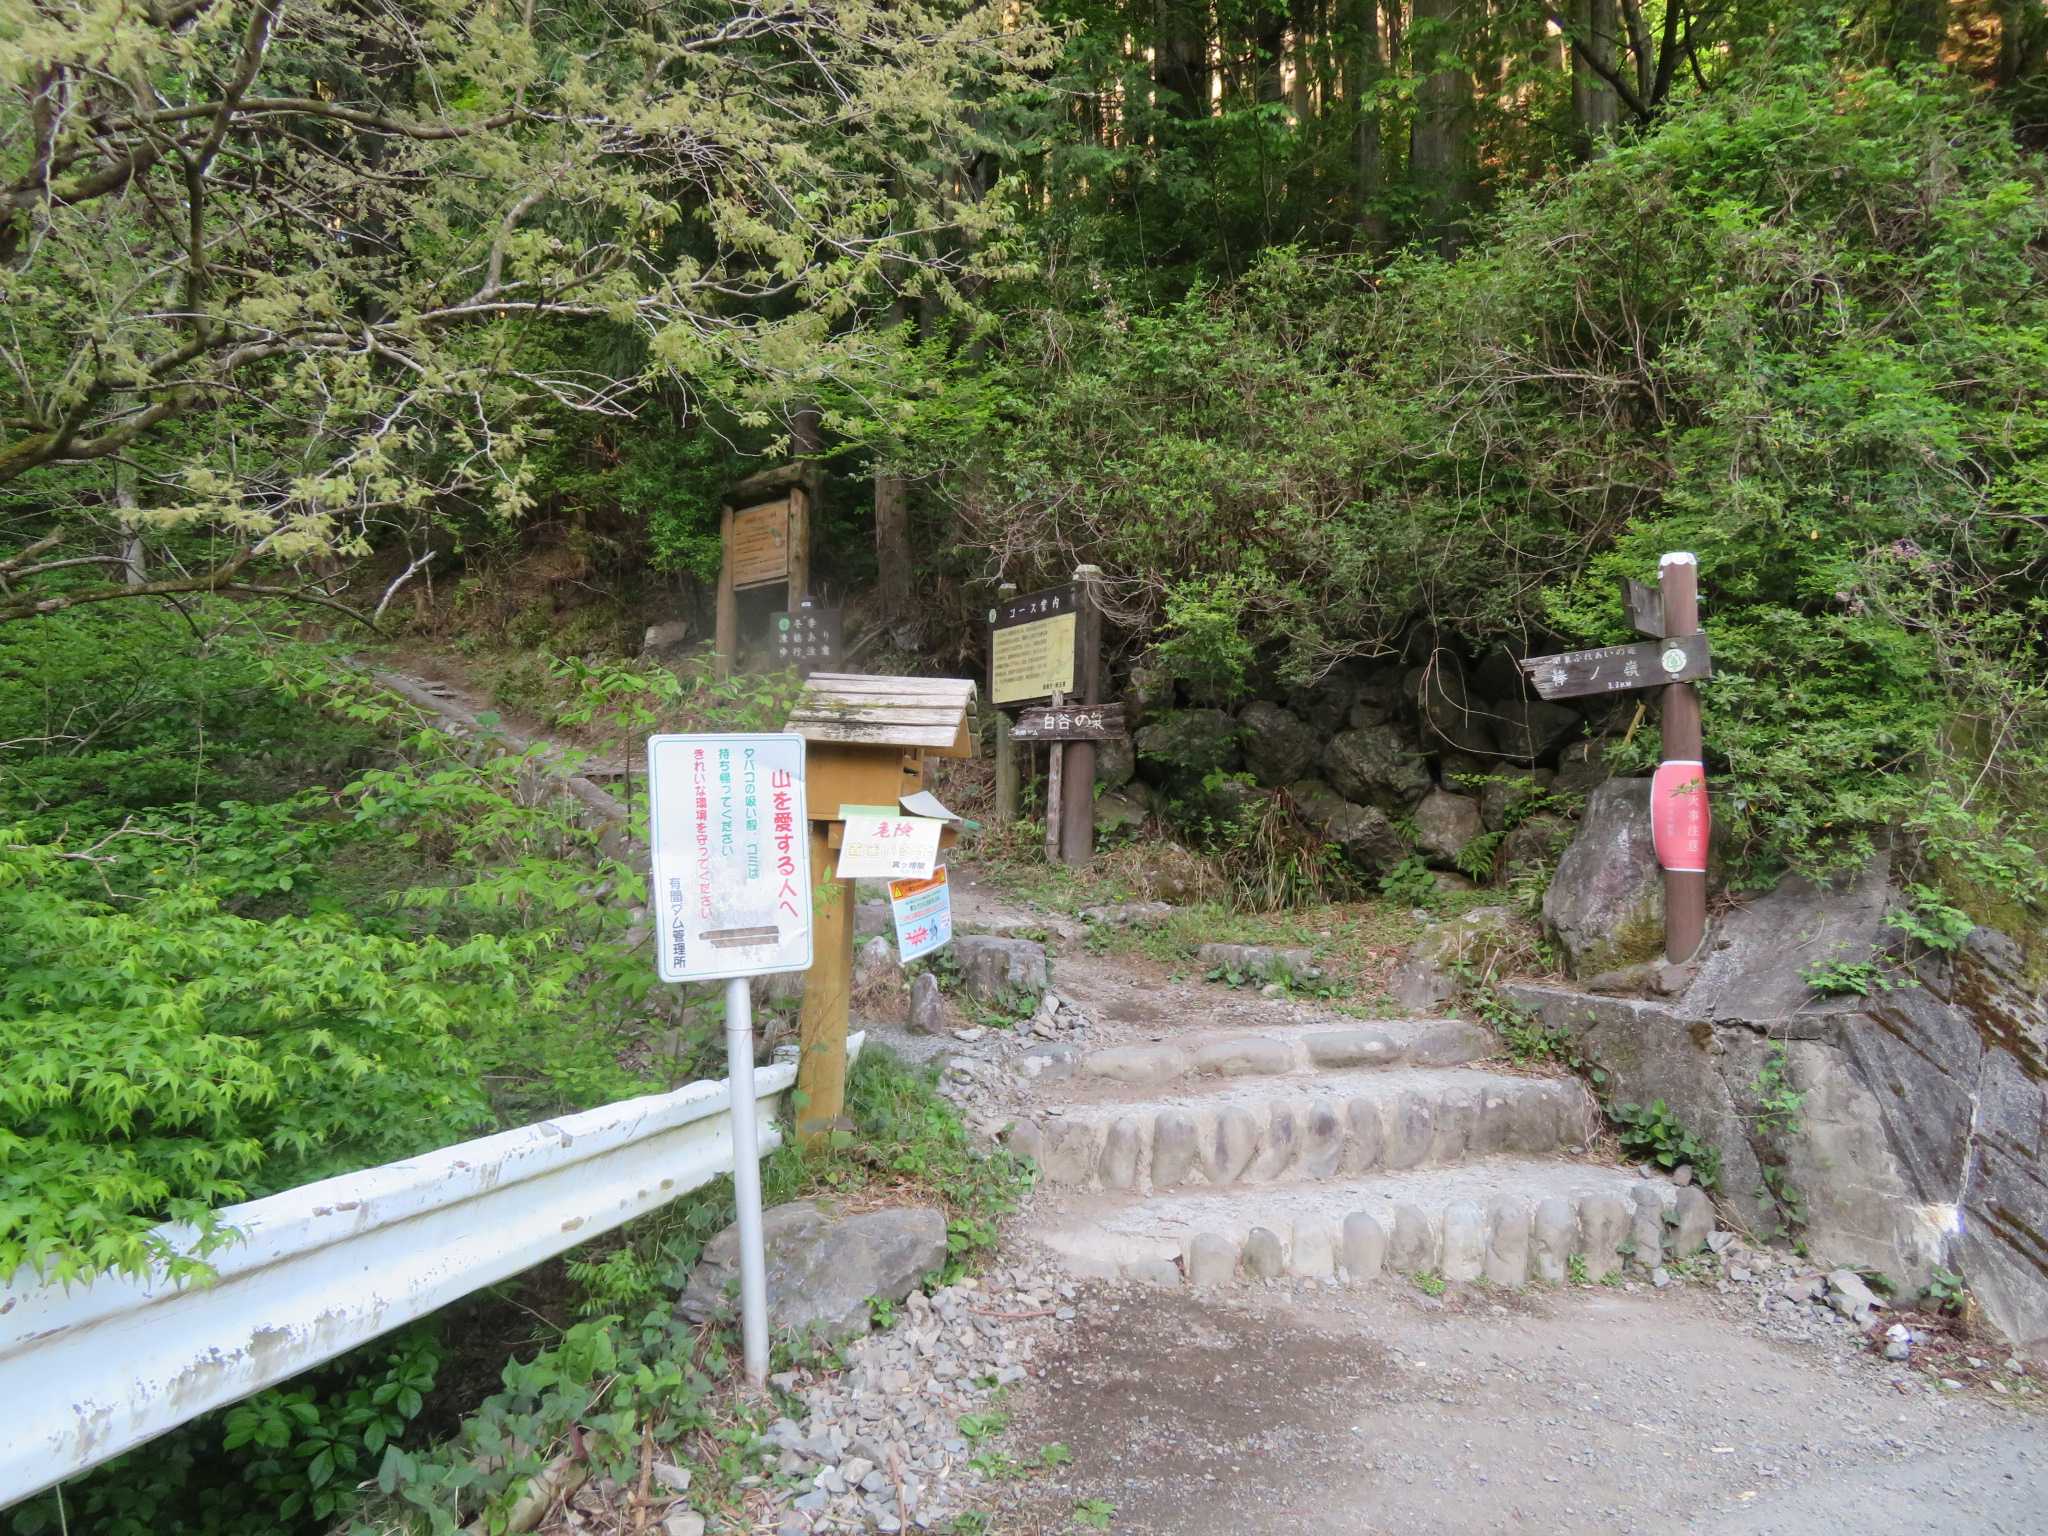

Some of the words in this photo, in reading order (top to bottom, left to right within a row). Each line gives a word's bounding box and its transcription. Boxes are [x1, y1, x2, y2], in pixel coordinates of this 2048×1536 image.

[1009, 596, 1060, 618] コース案内
[694, 748, 713, 920] きれいな環境を守ってください
[719, 748, 734, 857] 持ち帰ってください
[771, 769, 799, 918] 山を愛する人へ
